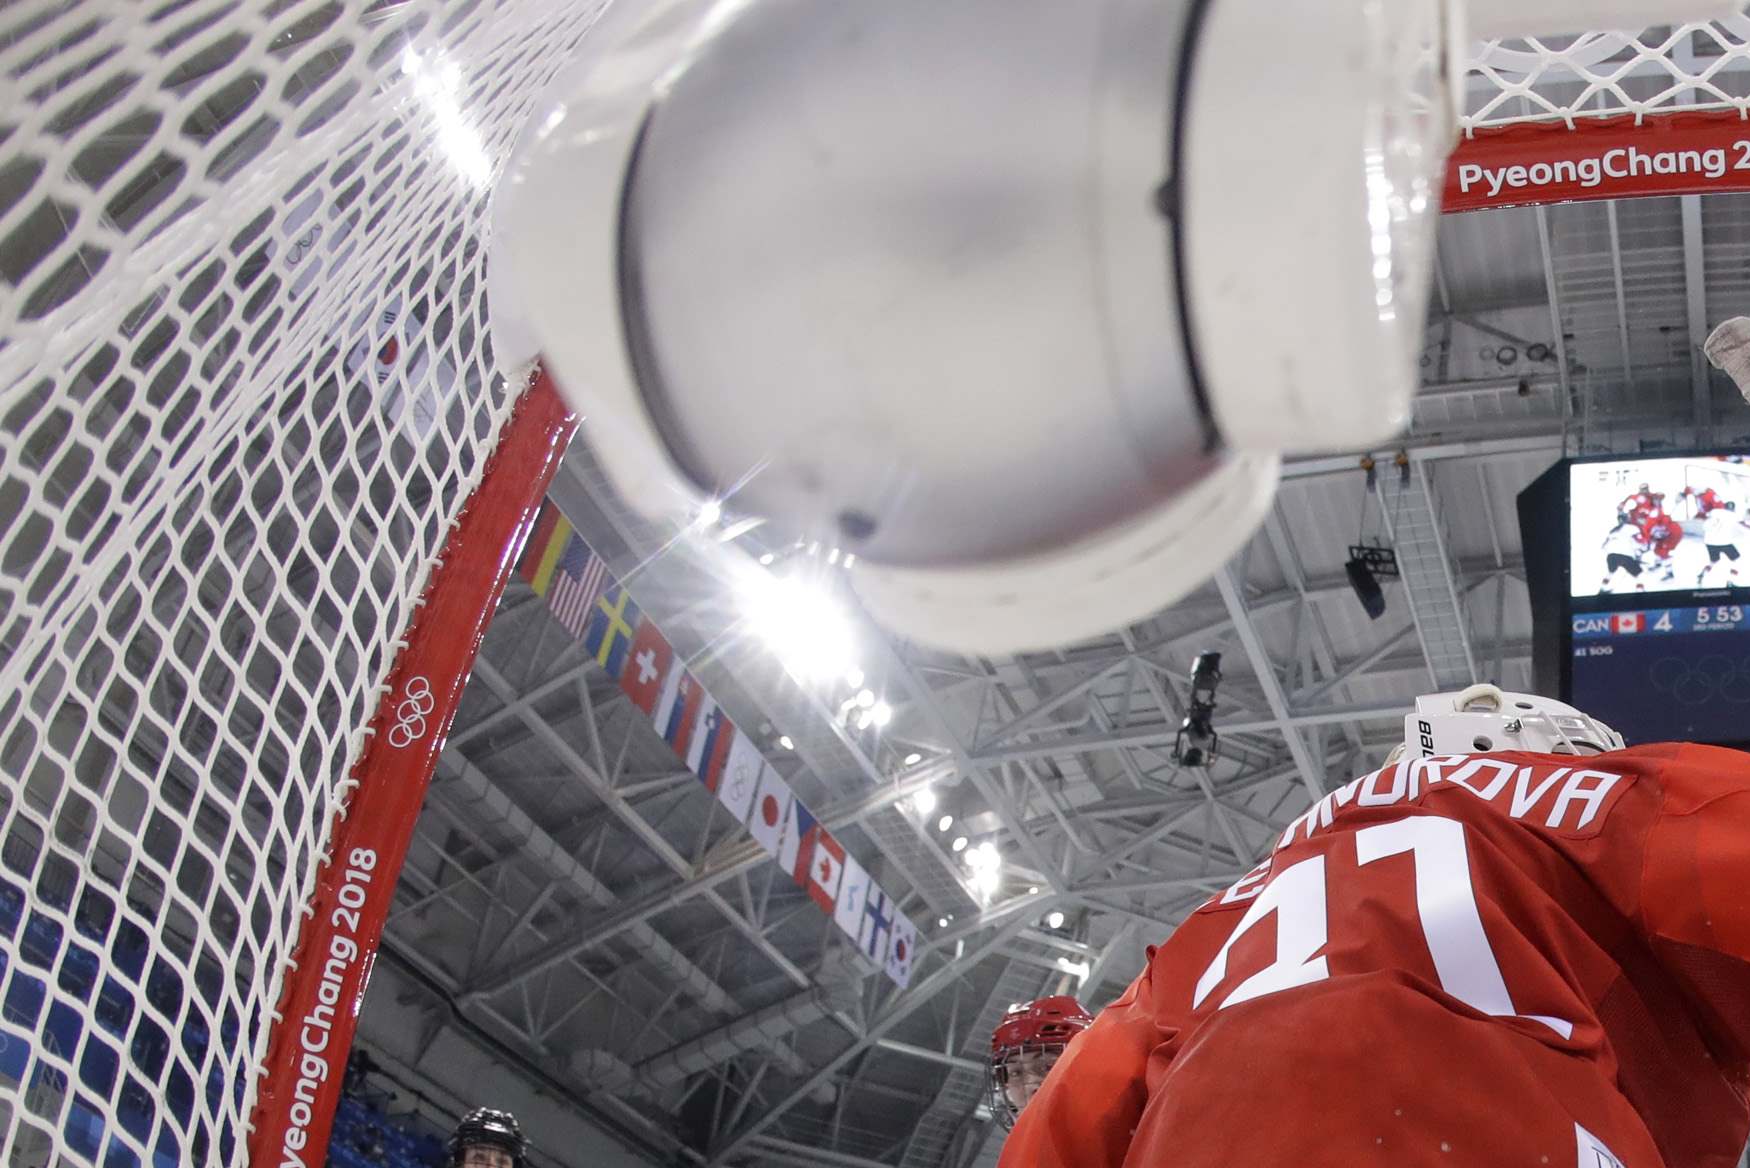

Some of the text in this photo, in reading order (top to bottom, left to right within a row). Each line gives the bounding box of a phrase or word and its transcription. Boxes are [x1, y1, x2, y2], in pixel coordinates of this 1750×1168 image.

[1458, 146, 1727, 197] PyeongChang
[1573, 618, 1609, 634] CAN
[1653, 610, 1673, 633] 4
[1589, 645, 1614, 656] SOG
[1418, 720, 1435, 758] BAU
[331, 846, 378, 932] 2018
